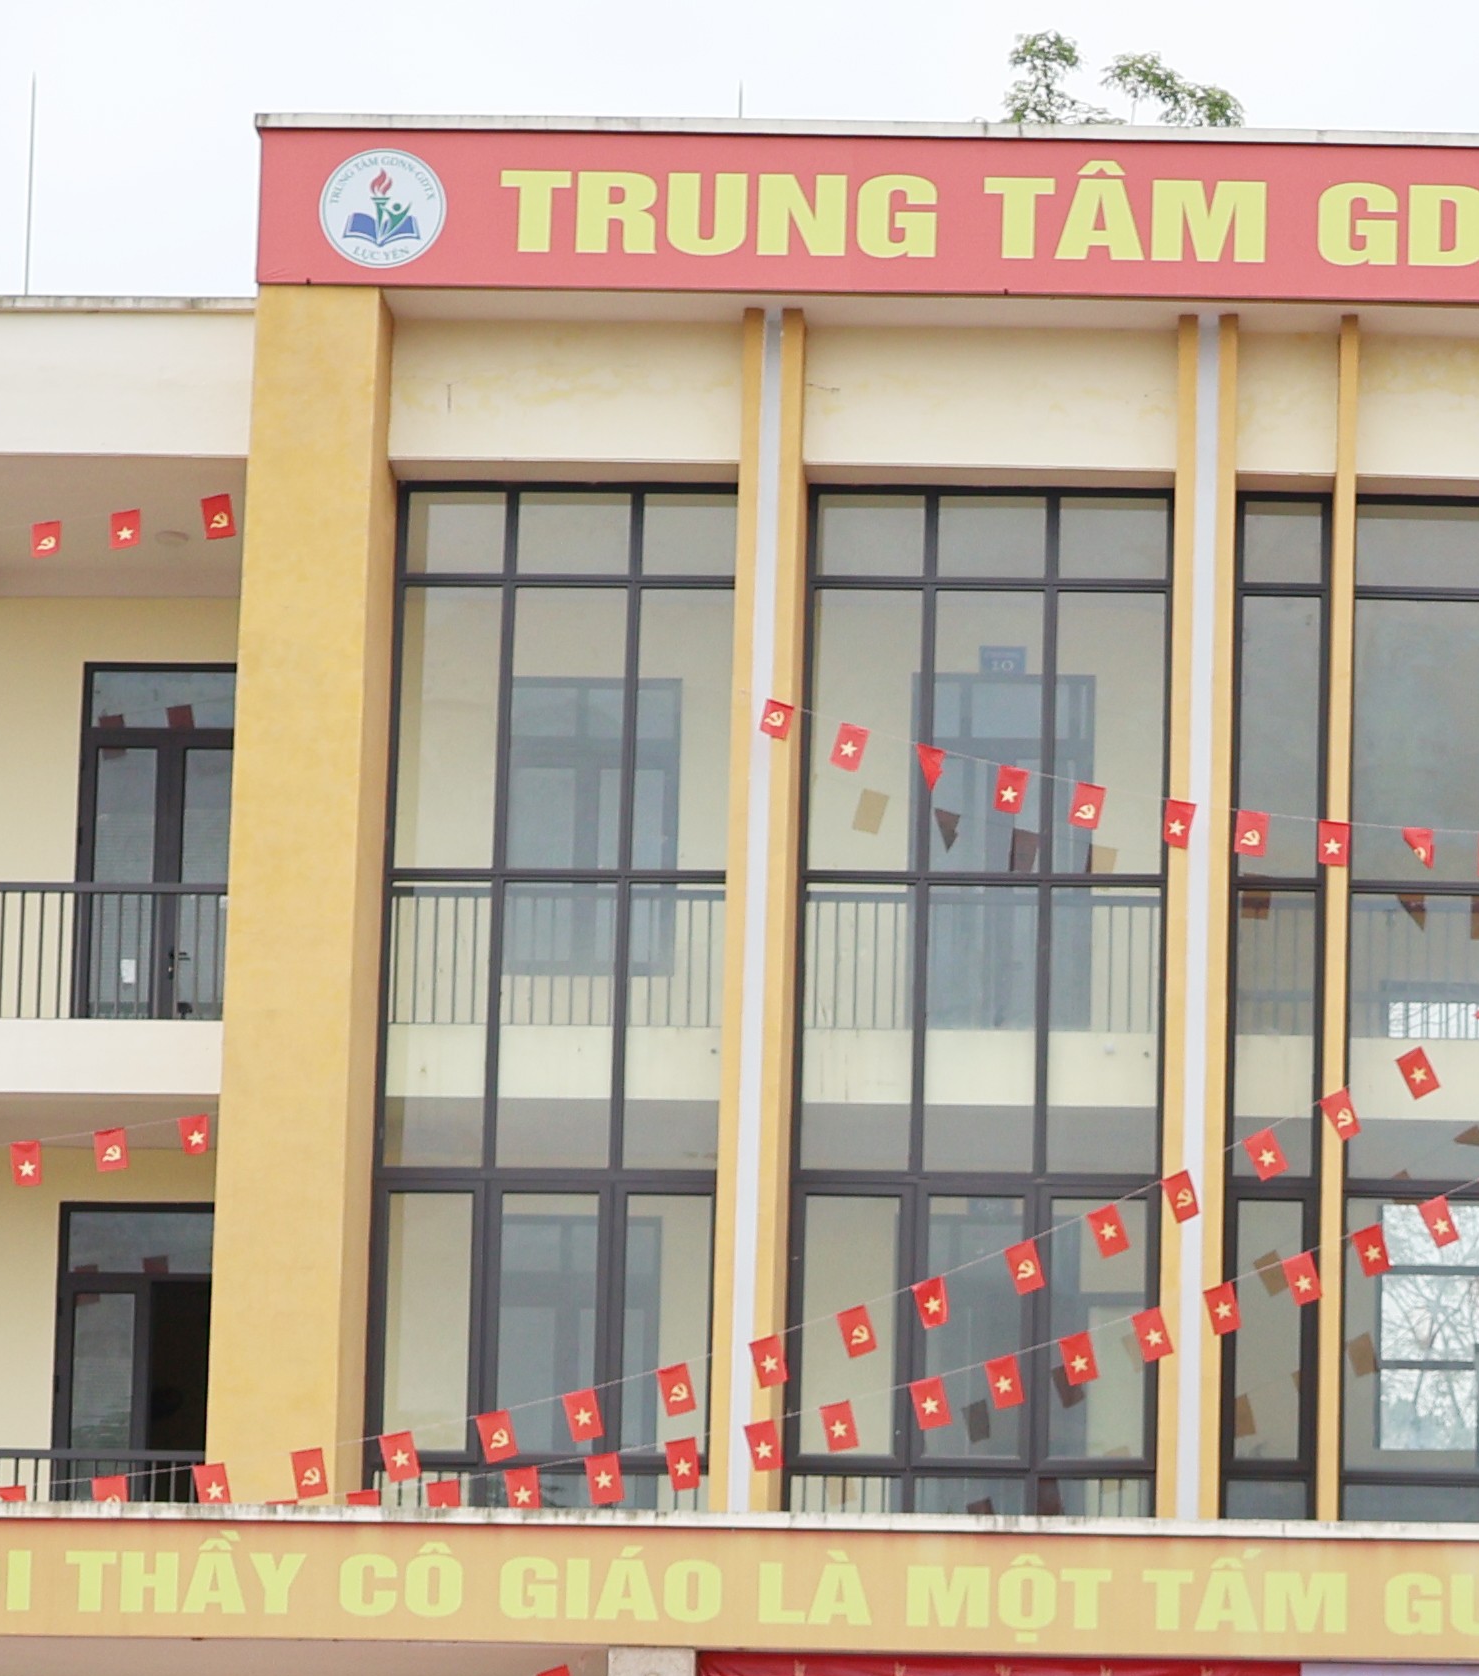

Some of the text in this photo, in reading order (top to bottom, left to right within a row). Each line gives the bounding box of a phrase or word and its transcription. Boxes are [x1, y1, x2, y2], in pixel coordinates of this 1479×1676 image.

[503, 171, 936, 256] TRUNG
[986, 161, 1265, 260] TÂM
[65, 1531, 307, 1616] THẦY
[338, 1541, 466, 1619] CÔ
[497, 1545, 725, 1626] GIÁO
[755, 1549, 873, 1628] LÀ
[904, 1543, 1114, 1645] MỘT
[1140, 1548, 1350, 1634] TẤM
